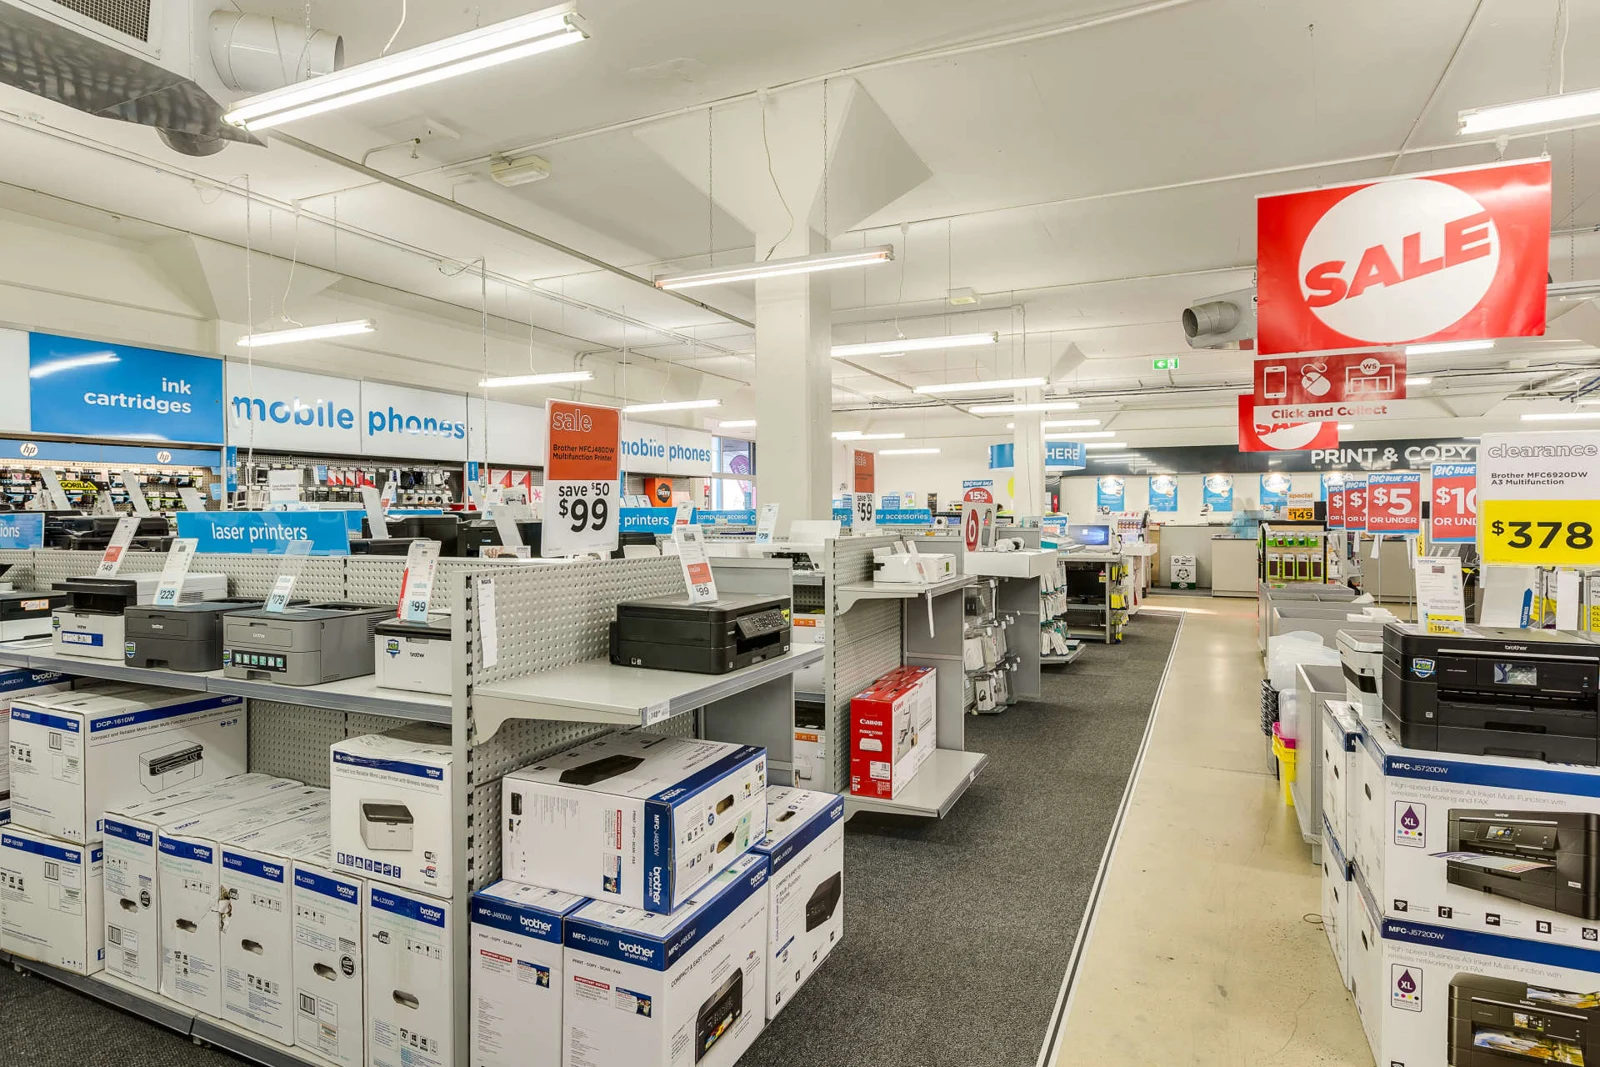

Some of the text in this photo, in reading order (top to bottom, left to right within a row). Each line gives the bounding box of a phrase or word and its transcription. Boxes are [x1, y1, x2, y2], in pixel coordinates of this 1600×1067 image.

[1304, 210, 1492, 308] SALE
[1362, 362, 1378, 371] WS
[161, 376, 192, 395] ink
[83, 388, 192, 416] cartridges
[232, 395, 465, 440] mobile phones
[1271, 405, 1388, 420] Click and Collect
[552, 408, 593, 433] sale
[22, 442, 37, 457] hp
[553, 444, 578, 453] Brother
[669, 442, 711, 463] phones
[1045, 447, 1079, 460] HERE
[1311, 446, 1472, 465] PRINT & COPY
[1488, 443, 1599, 459] clearance
[158, 451, 170, 463] hp
[553, 453, 612, 462] Multifunction Printer
[1454, 466, 1476, 474] BLUE
[1526, 471, 1588, 479] MFC6920DW
[1505, 478, 1565, 486] Multifunction
[558, 482, 610, 497] save $50
[1373, 487, 1413, 516] $5
[558, 498, 609, 533] $99
[857, 502, 873, 521] $59
[885, 512, 928, 520] accessories
[1289, 511, 1313, 520] $149
[624, 514, 670, 528] printers
[1386, 516, 1417, 524] UNDER
[1434, 517, 1452, 526] OR
[211, 522, 308, 543] laser printers
[1491, 520, 1594, 549] $378
[160, 589, 176, 600] $229
[696, 586, 710, 596] $99
[411, 600, 426, 612] $99
[859, 718, 883, 727] Canon
[1391, 762, 1449, 774] MFC-J5720DW
[1432, 785, 1465, 796] Business
[1466, 788, 1477, 797] A3
[1458, 796, 1473, 804] and
[1403, 816, 1417, 827] XL
[652, 866, 662, 905] brother
[419, 906, 442, 919] brother
[478, 907, 513, 921] MFC-J480DW
[519, 915, 552, 932] brother
[572, 931, 610, 947] MFC-J480DW
[1388, 925, 1445, 940] MFC-J5720DW
[618, 940, 655, 958] brother
[1415, 955, 1453, 969] networking
[1454, 963, 1469, 972] and
[1469, 966, 1485, 974] FAX
[1428, 949, 1461, 962] Business
[1545, 970, 1562, 979] with
[1400, 980, 1413, 991] XL
